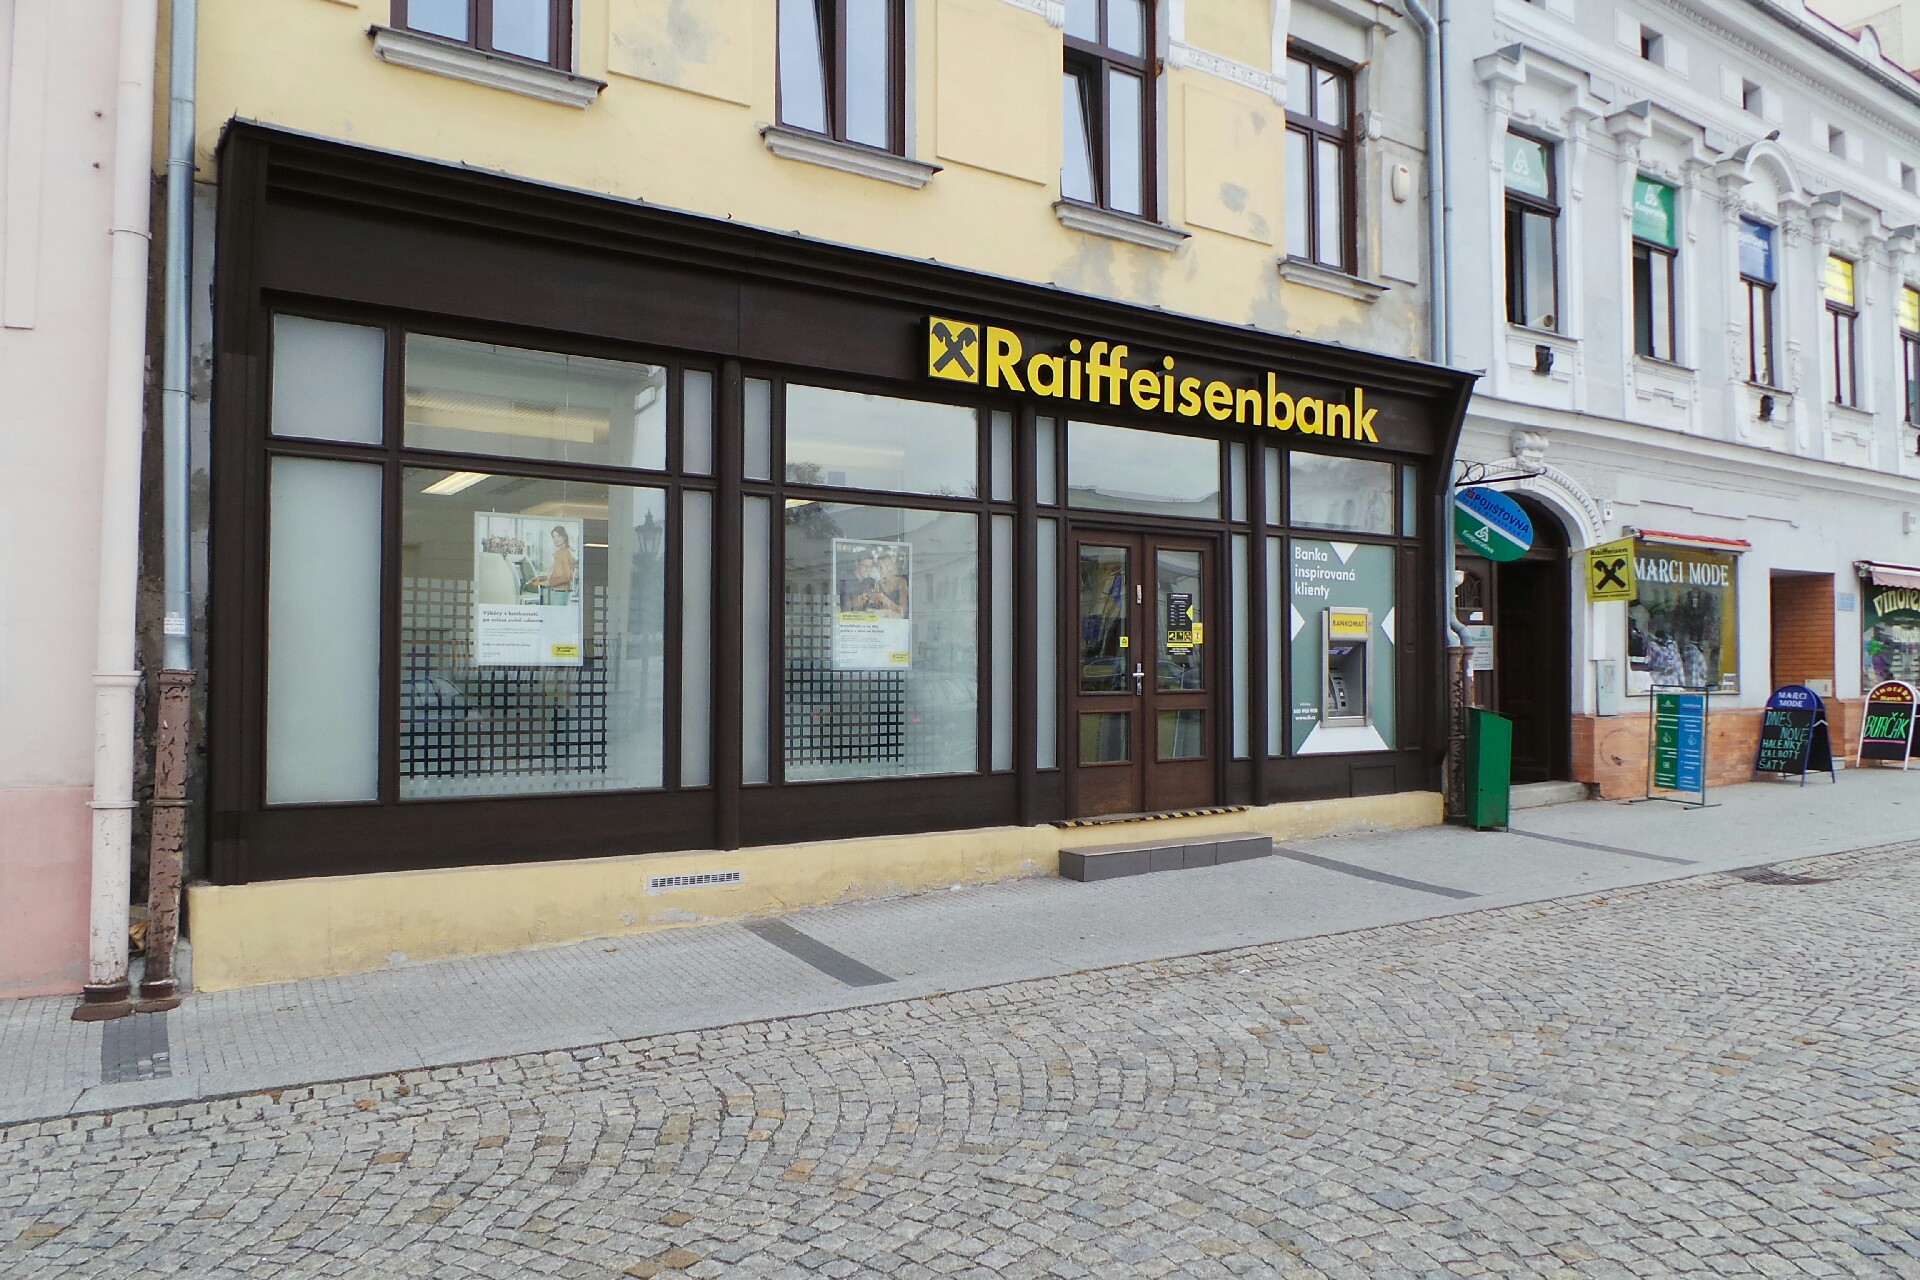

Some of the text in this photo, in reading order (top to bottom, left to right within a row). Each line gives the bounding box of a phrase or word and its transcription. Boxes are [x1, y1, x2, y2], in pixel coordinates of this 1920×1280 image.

[985, 325, 1379, 443] Raiffeisenbank
[1294, 546, 1328, 562] Banka
[1590, 546, 1628, 556] Raiffeisen
[1294, 564, 1356, 581] inspirovaná
[1633, 557, 1730, 587] MARCI MODE
[1294, 581, 1330, 600] klienty
[1332, 619, 1365, 628] BANKOMAT
[1778, 691, 1808, 700] MARCI
[1780, 699, 1804, 708] MODE
[1765, 711, 1793, 727] DNES
[1864, 712, 1910, 739] BURČÁK
[1758, 758, 1787, 770] ŠATY
